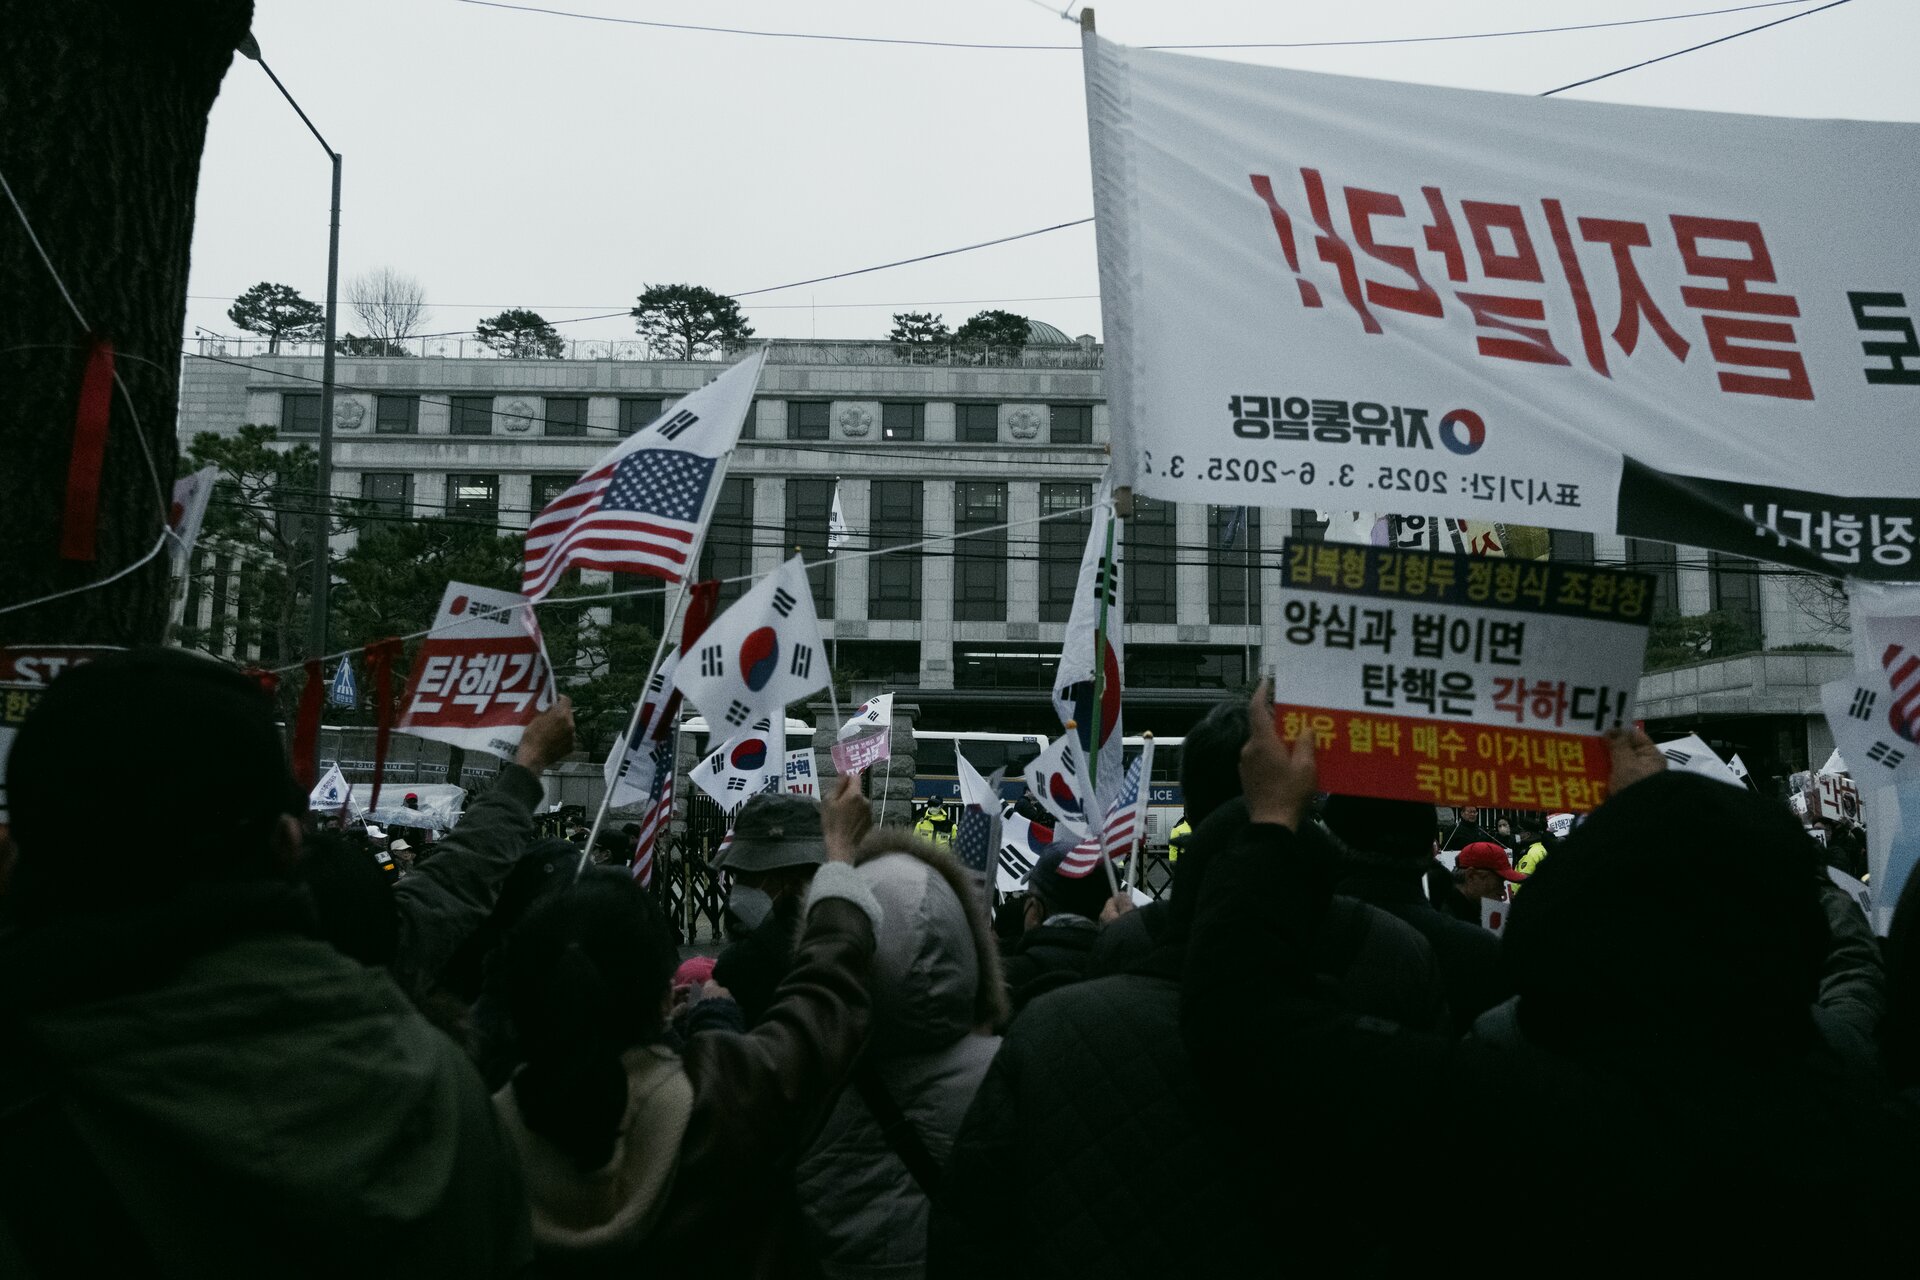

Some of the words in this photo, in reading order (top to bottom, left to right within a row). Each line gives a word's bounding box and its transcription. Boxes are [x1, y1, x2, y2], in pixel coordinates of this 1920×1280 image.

[1289, 543, 1367, 590] 김복형
[1377, 553, 1457, 598] 김형두
[1467, 561, 1549, 607] 정형식
[1556, 570, 1647, 618] 조한창
[1284, 600, 1396, 654] 양심과
[1412, 613, 1525, 666] 법이면
[1363, 663, 1476, 717] 탄핵은
[1491, 676, 1628, 732] 각하다!
[786, 760, 811, 781] 탄핵
[1347, 717, 1401, 758] 협박
[1411, 725, 1467, 763] 매수
[1476, 732, 1586, 773] 이겨내면
[1148, 790, 1173, 801] LICE
[1414, 762, 1498, 805] 국민이
